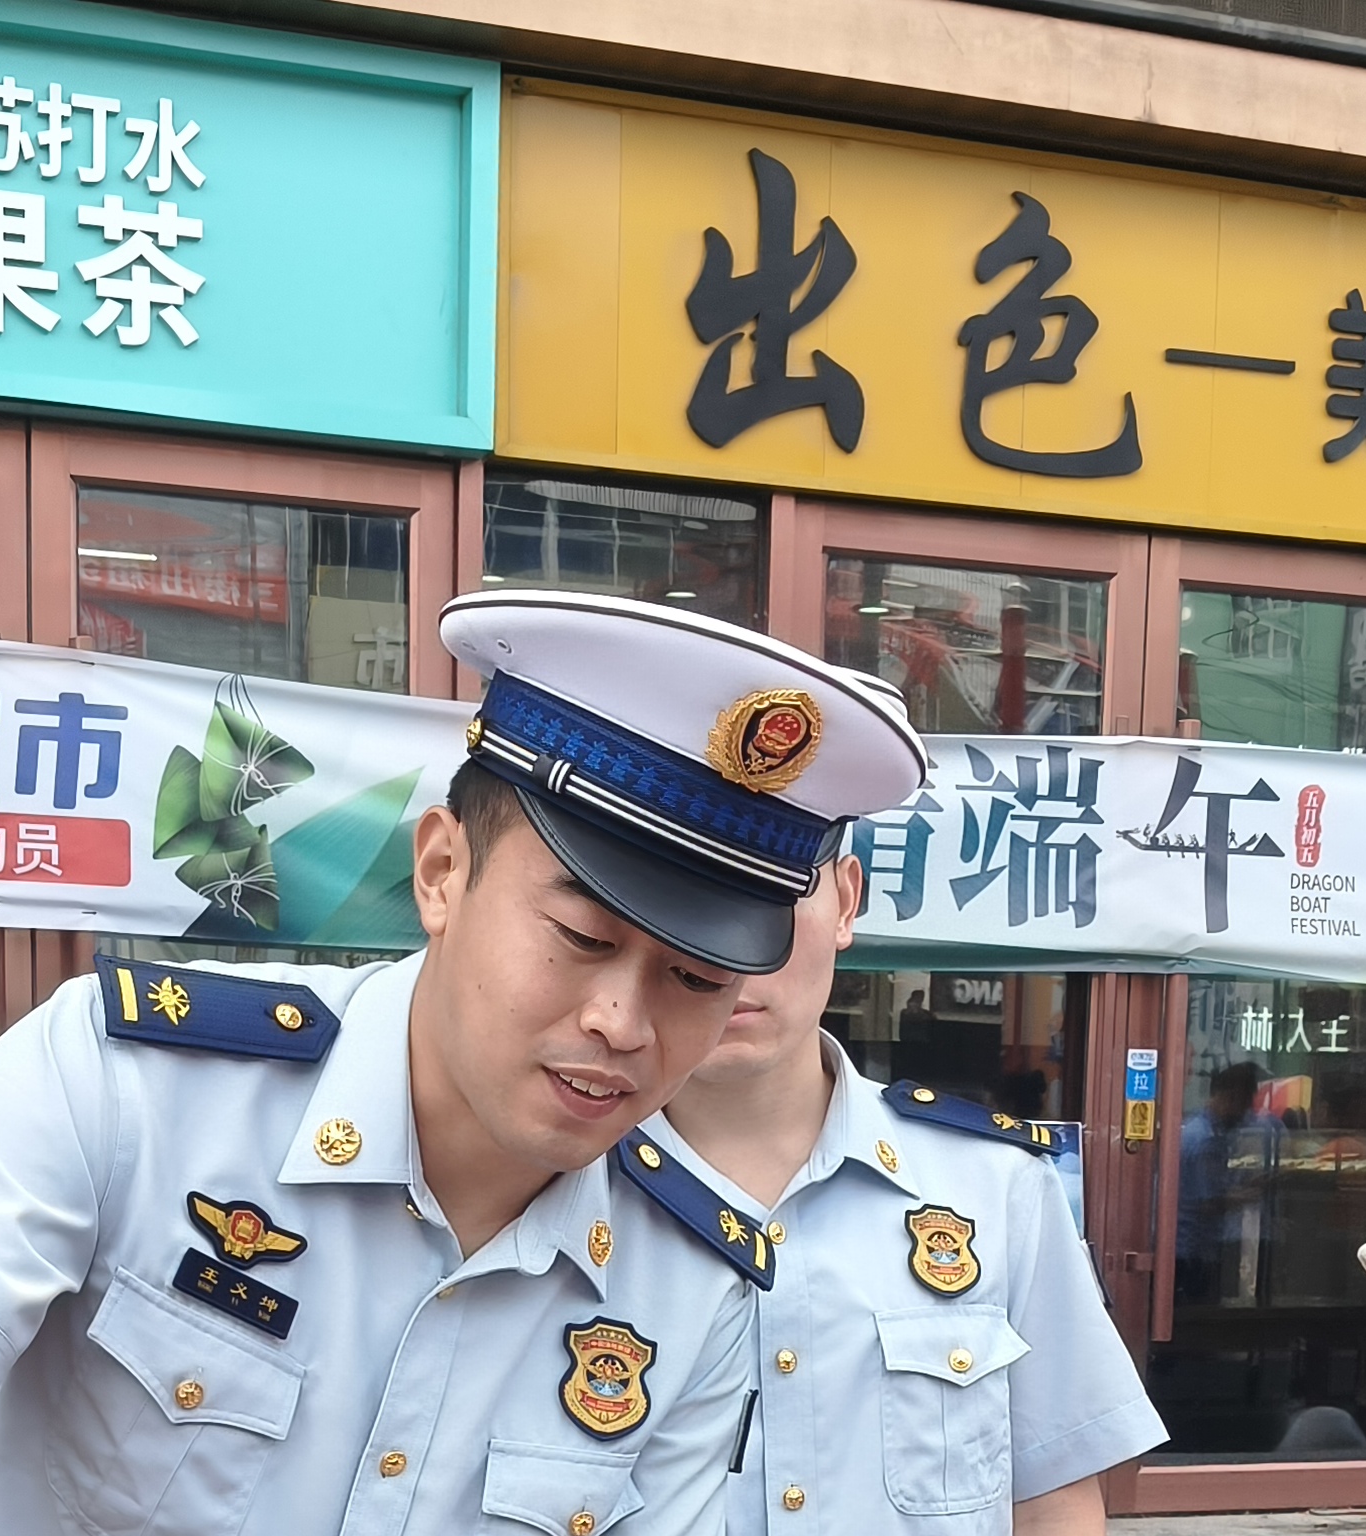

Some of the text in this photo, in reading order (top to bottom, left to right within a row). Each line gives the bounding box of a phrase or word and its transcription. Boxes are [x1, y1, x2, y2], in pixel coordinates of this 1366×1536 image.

[1299, 789, 1320, 864] 五月初五
[1290, 872, 1356, 893] DRAGON
[1290, 895, 1331, 914] BOAT
[1291, 917, 1361, 937] FESTIVAL
[1133, 1072, 1149, 1094] 拉
